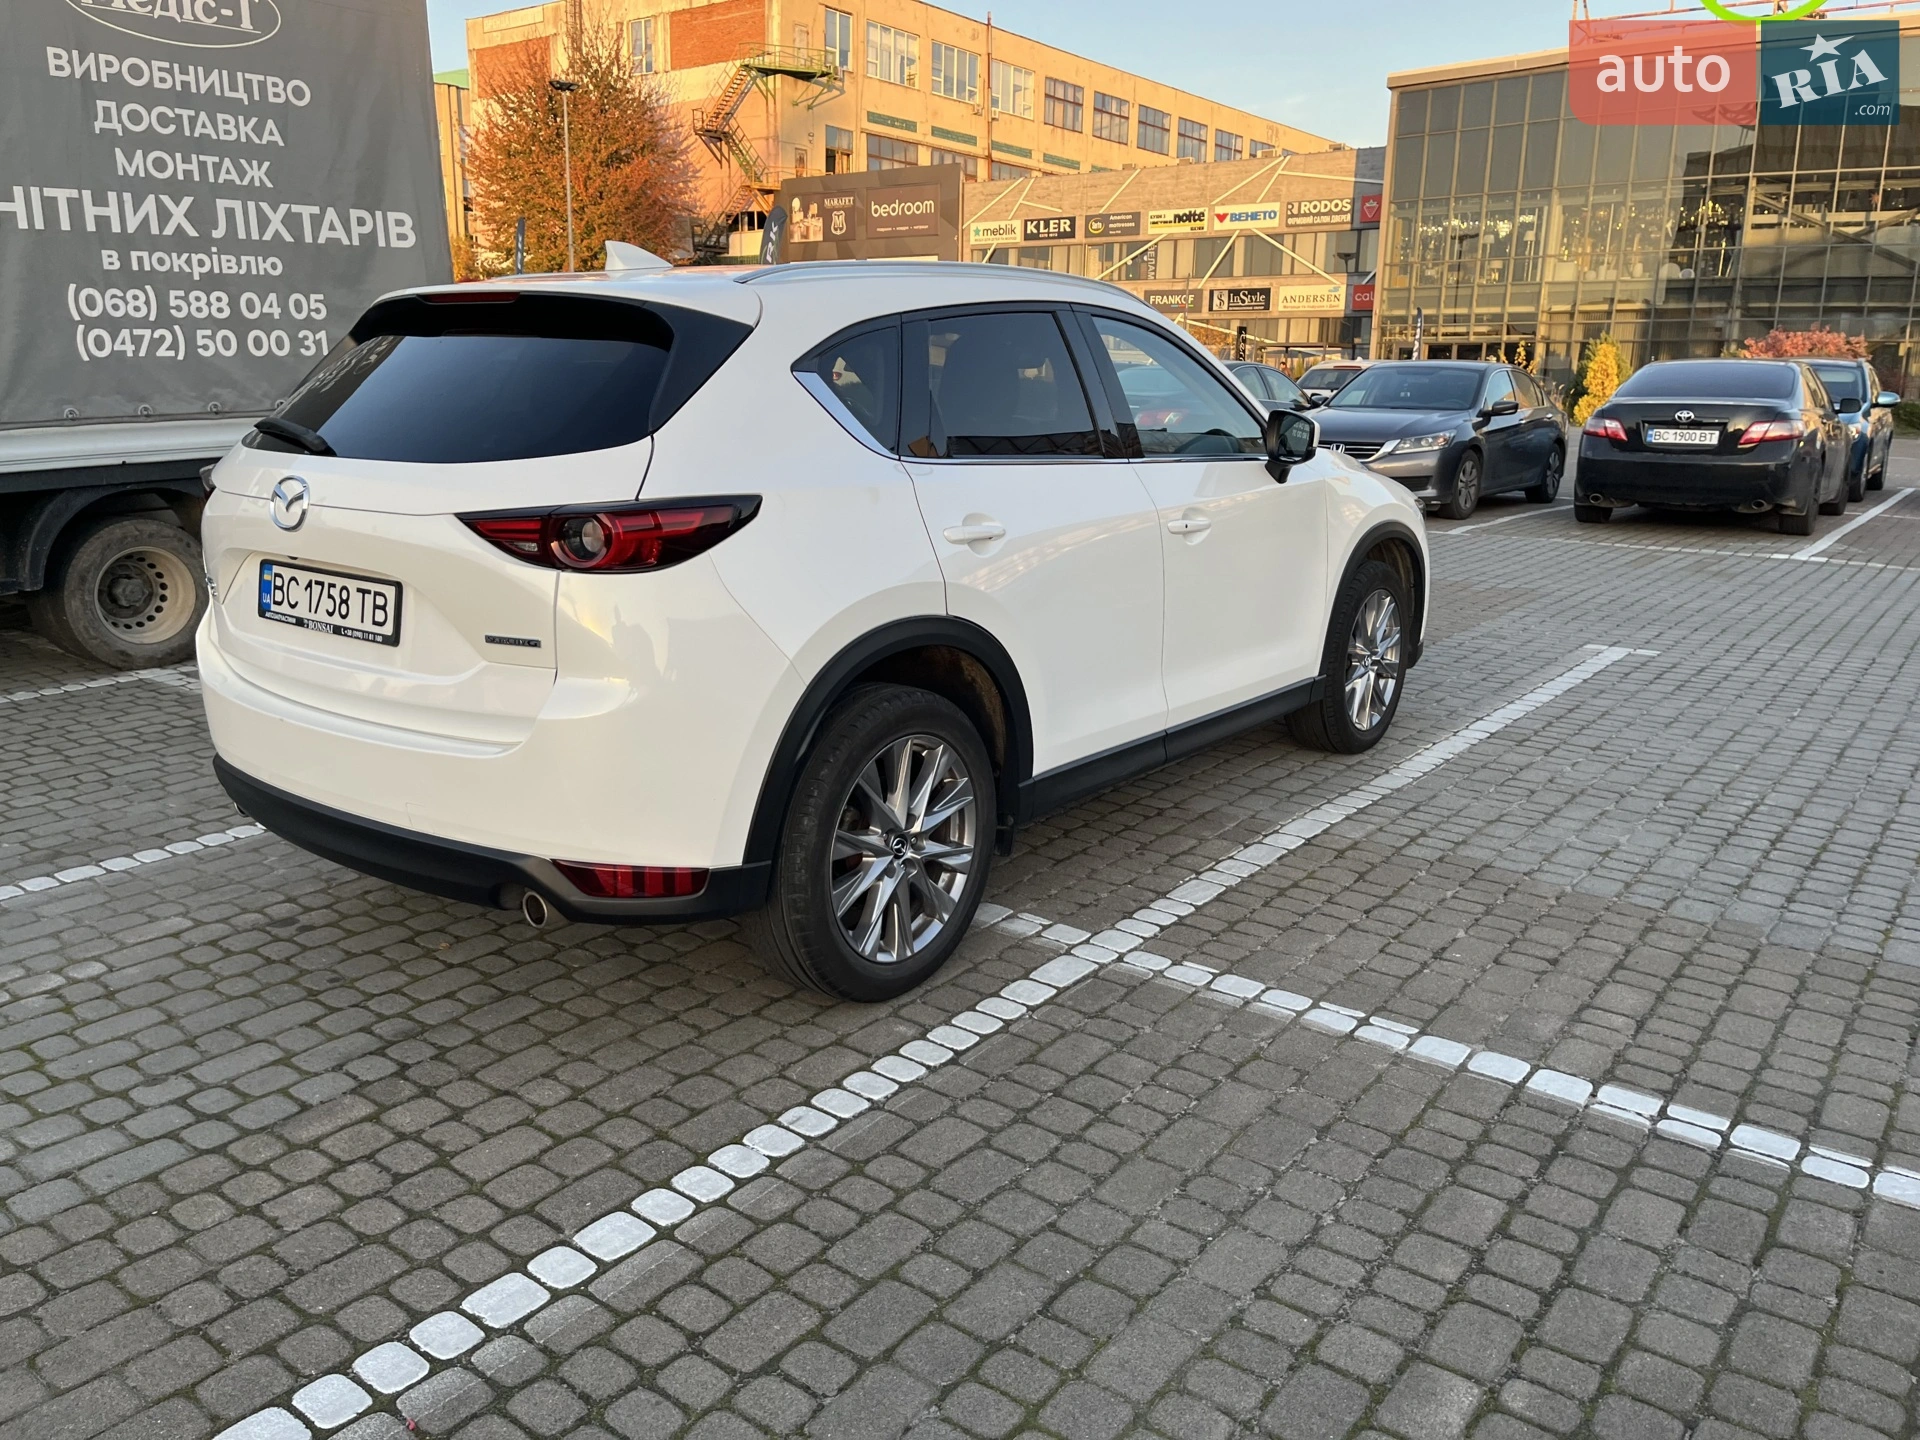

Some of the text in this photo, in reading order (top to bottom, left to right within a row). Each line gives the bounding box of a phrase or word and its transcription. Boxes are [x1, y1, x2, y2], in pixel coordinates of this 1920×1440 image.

[46, 46, 311, 107] ВИРОБНИЦТВО
[94, 100, 285, 146] ДОСТАВКА
[114, 147, 273, 188] МОНТАЖ
[824, 197, 854, 206] MARAFET
[871, 199, 935, 218] bedroom
[1300, 199, 1351, 214] RODOS
[212, 198, 417, 249] ЛІХТАРІВ
[1173, 209, 1205, 224] nolte
[982, 224, 1017, 237] meblik
[1026, 219, 1071, 234] KLER
[102, 246, 283, 281] в покрівлю
[67, 284, 327, 321] (068) 588 04 05
[1229, 290, 1266, 306] InStyle
[1281, 294, 1341, 303] ANDERSEN
[76, 325, 329, 361] (0472) 50 00 31
[1653, 431, 1716, 442] BC 1900 BT
[262, 593, 271, 605] UA
[273, 572, 389, 627] BC 1758 TB
[308, 620, 334, 634] BONSAI
